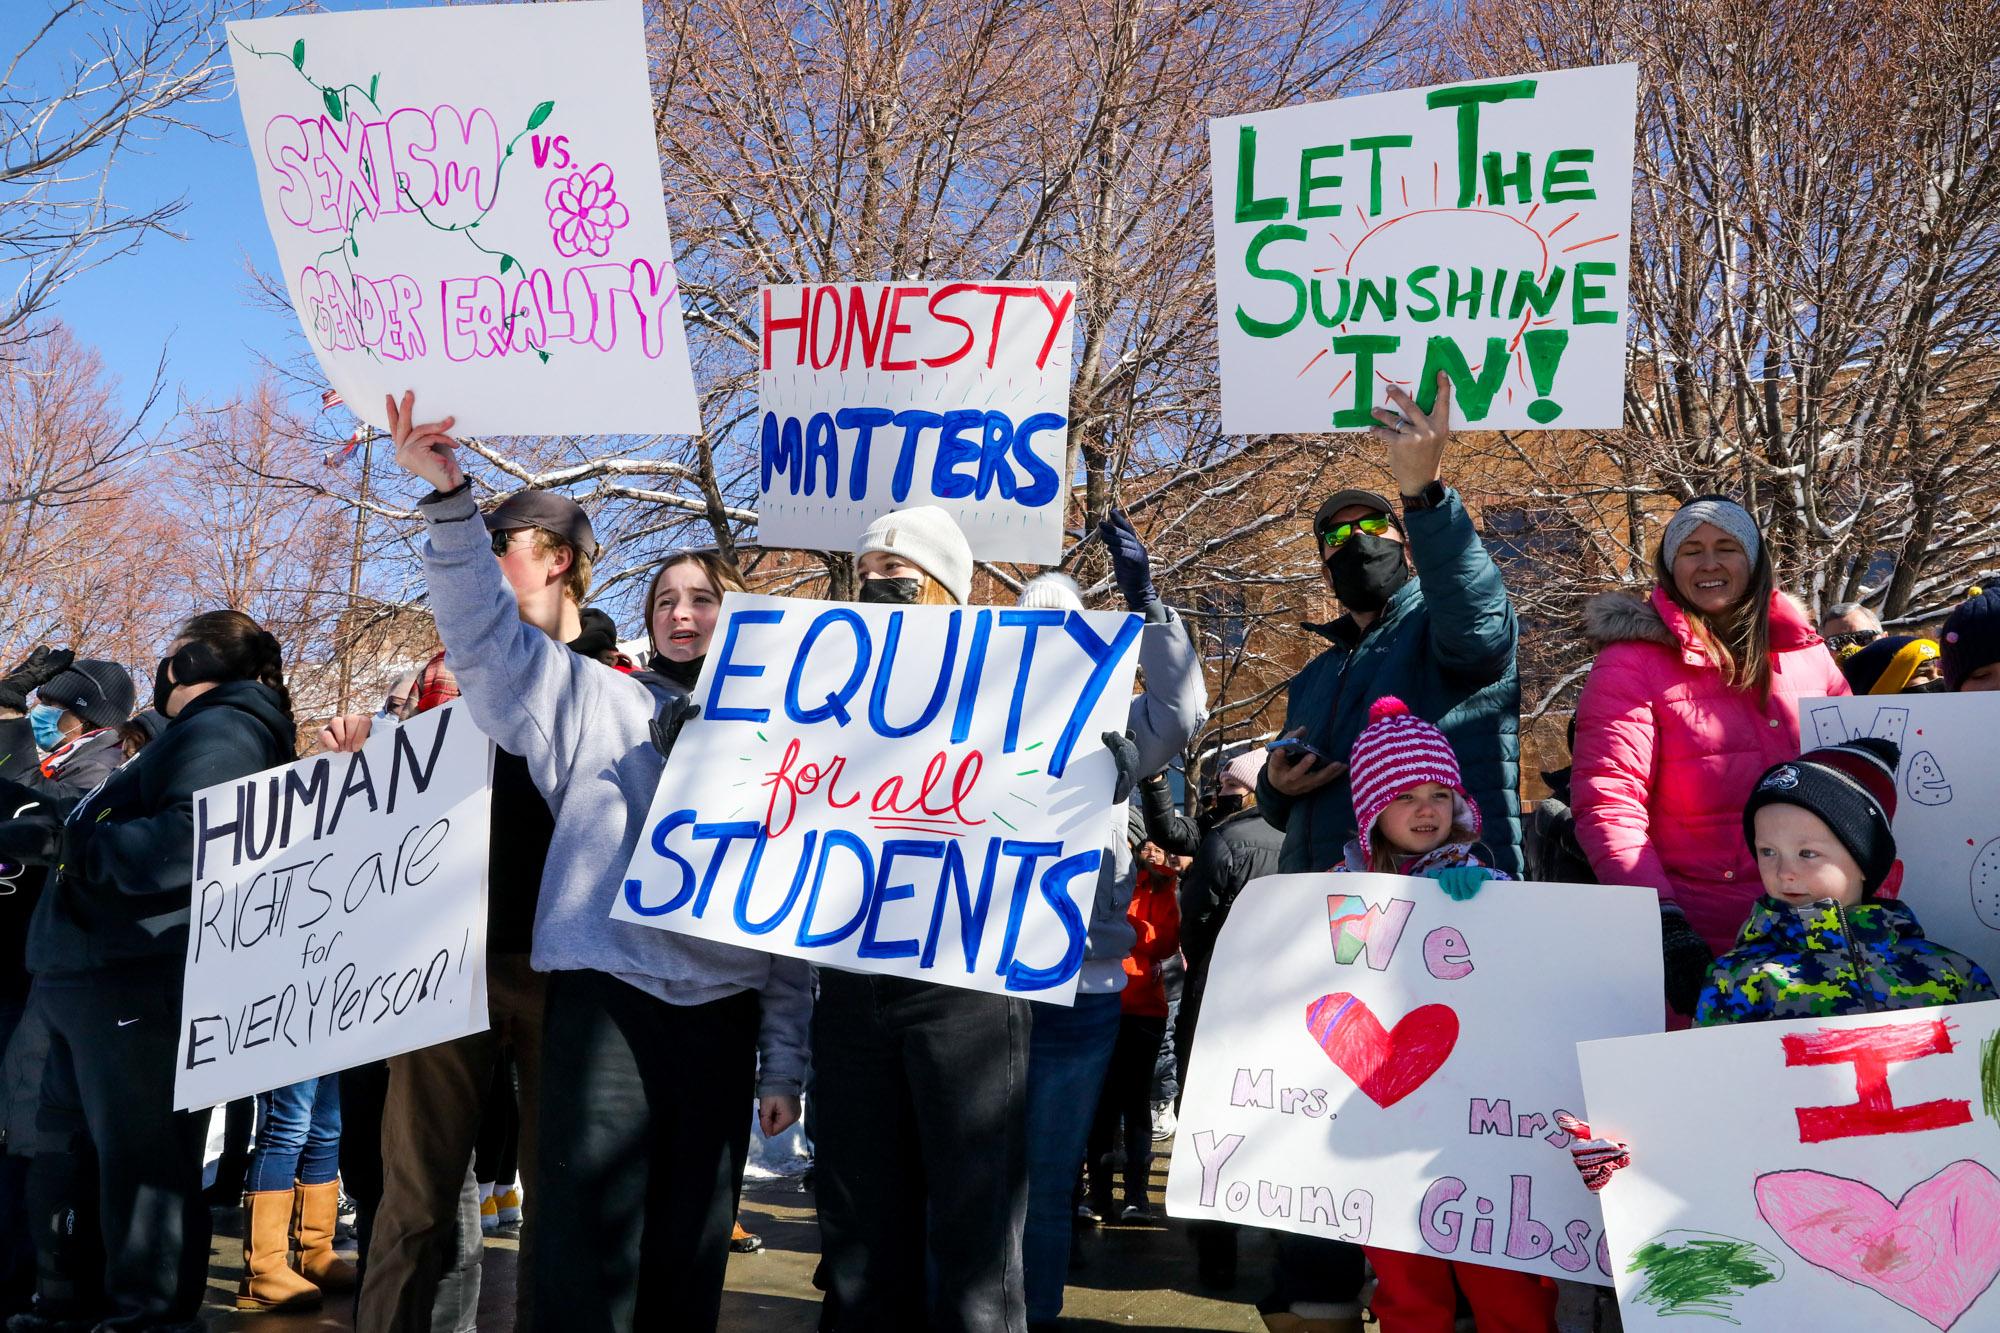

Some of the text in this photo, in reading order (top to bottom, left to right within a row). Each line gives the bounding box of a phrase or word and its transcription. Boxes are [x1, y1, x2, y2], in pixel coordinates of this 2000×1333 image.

[265, 105, 501, 233] SEXISM
[1235, 80, 1597, 223] LET THE
[301, 266, 427, 361] GENDER
[763, 284, 1075, 371] HONESTY
[1235, 224, 1619, 338] SUNSHINE
[1332, 329, 1569, 428] IN!
[761, 408, 1067, 508] MATTERS
[703, 608, 1145, 779] EQUITY
[197, 707, 452, 881] HUMAN
[761, 738, 987, 839] for all
[195, 818, 451, 964] RIGHTS are
[624, 809, 1101, 991] STUDENTS
[1326, 894, 1475, 980] We
[301, 931, 342, 969] for
[1230, 1068, 1339, 1121] Mrs.
[1780, 1016, 1974, 1144] I
[1192, 1130, 1374, 1245] Young
